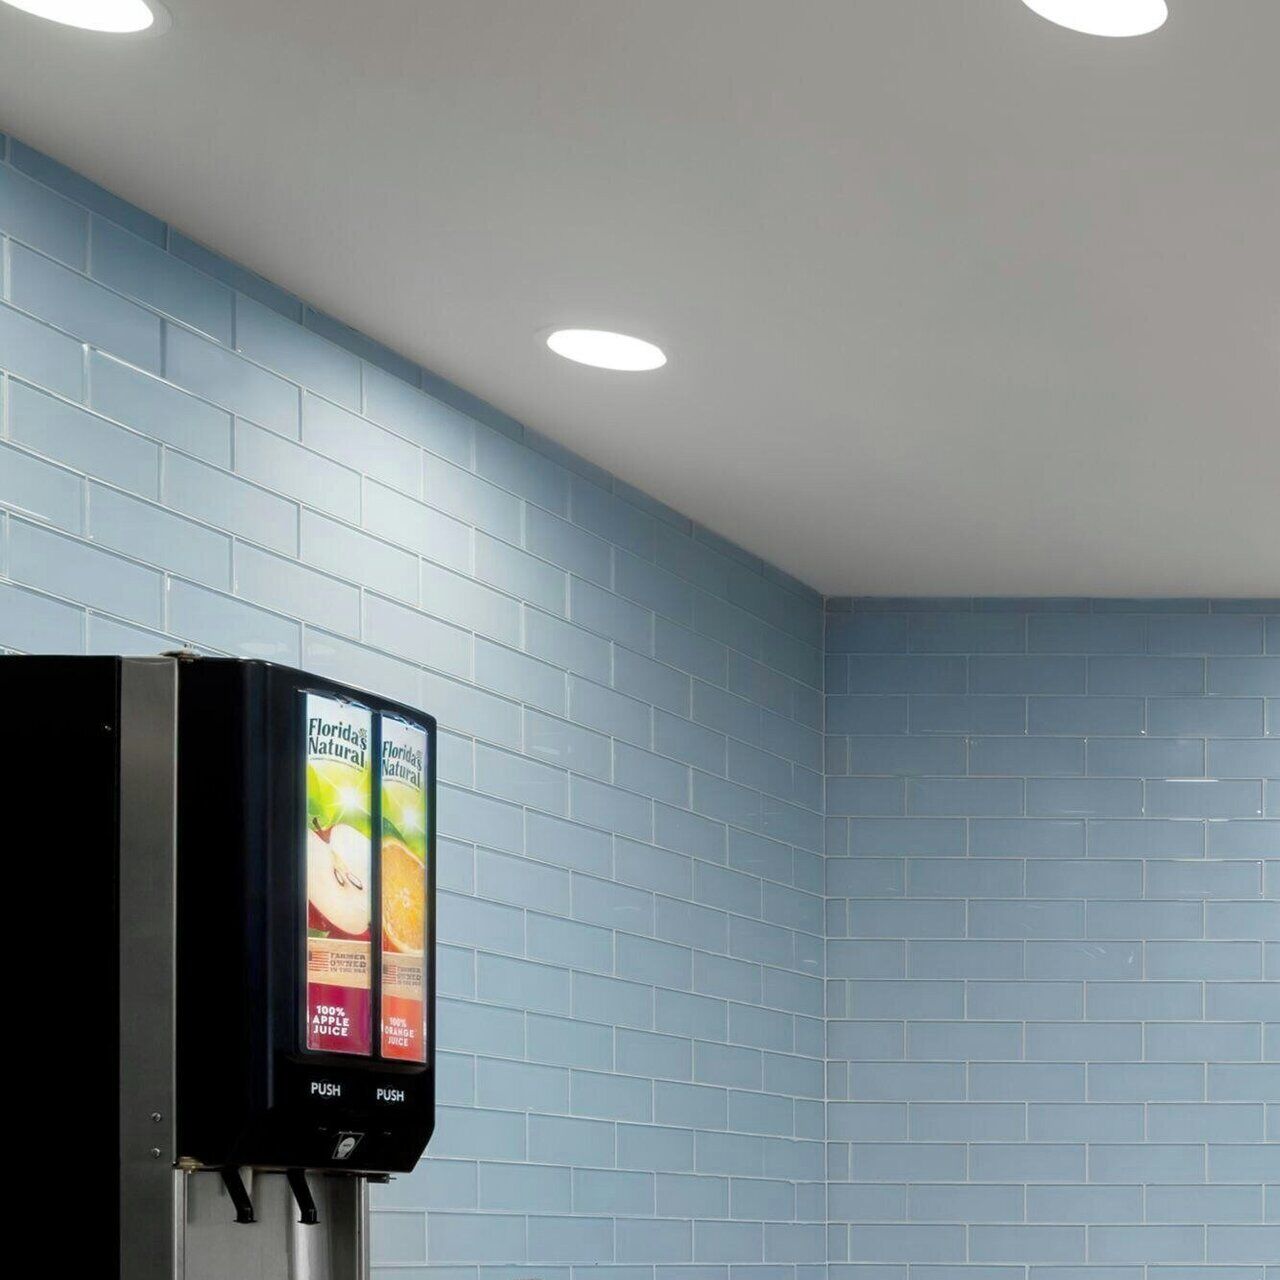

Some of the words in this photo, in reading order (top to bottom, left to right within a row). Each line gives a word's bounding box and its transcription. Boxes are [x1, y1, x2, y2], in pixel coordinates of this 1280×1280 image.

[309, 737, 365, 768] Natural
[382, 760, 420, 788] Natural
[330, 960, 367, 968] OWNED
[316, 1005, 345, 1017] 100%
[313, 1014, 350, 1027] APPLE
[390, 1017, 407, 1028] 100%
[313, 1025, 348, 1037] JUICE
[385, 1026, 415, 1038] ORANGE
[388, 1037, 408, 1047] JUICE
[311, 1082, 341, 1097] PUSH
[376, 1088, 405, 1102] PUSH
